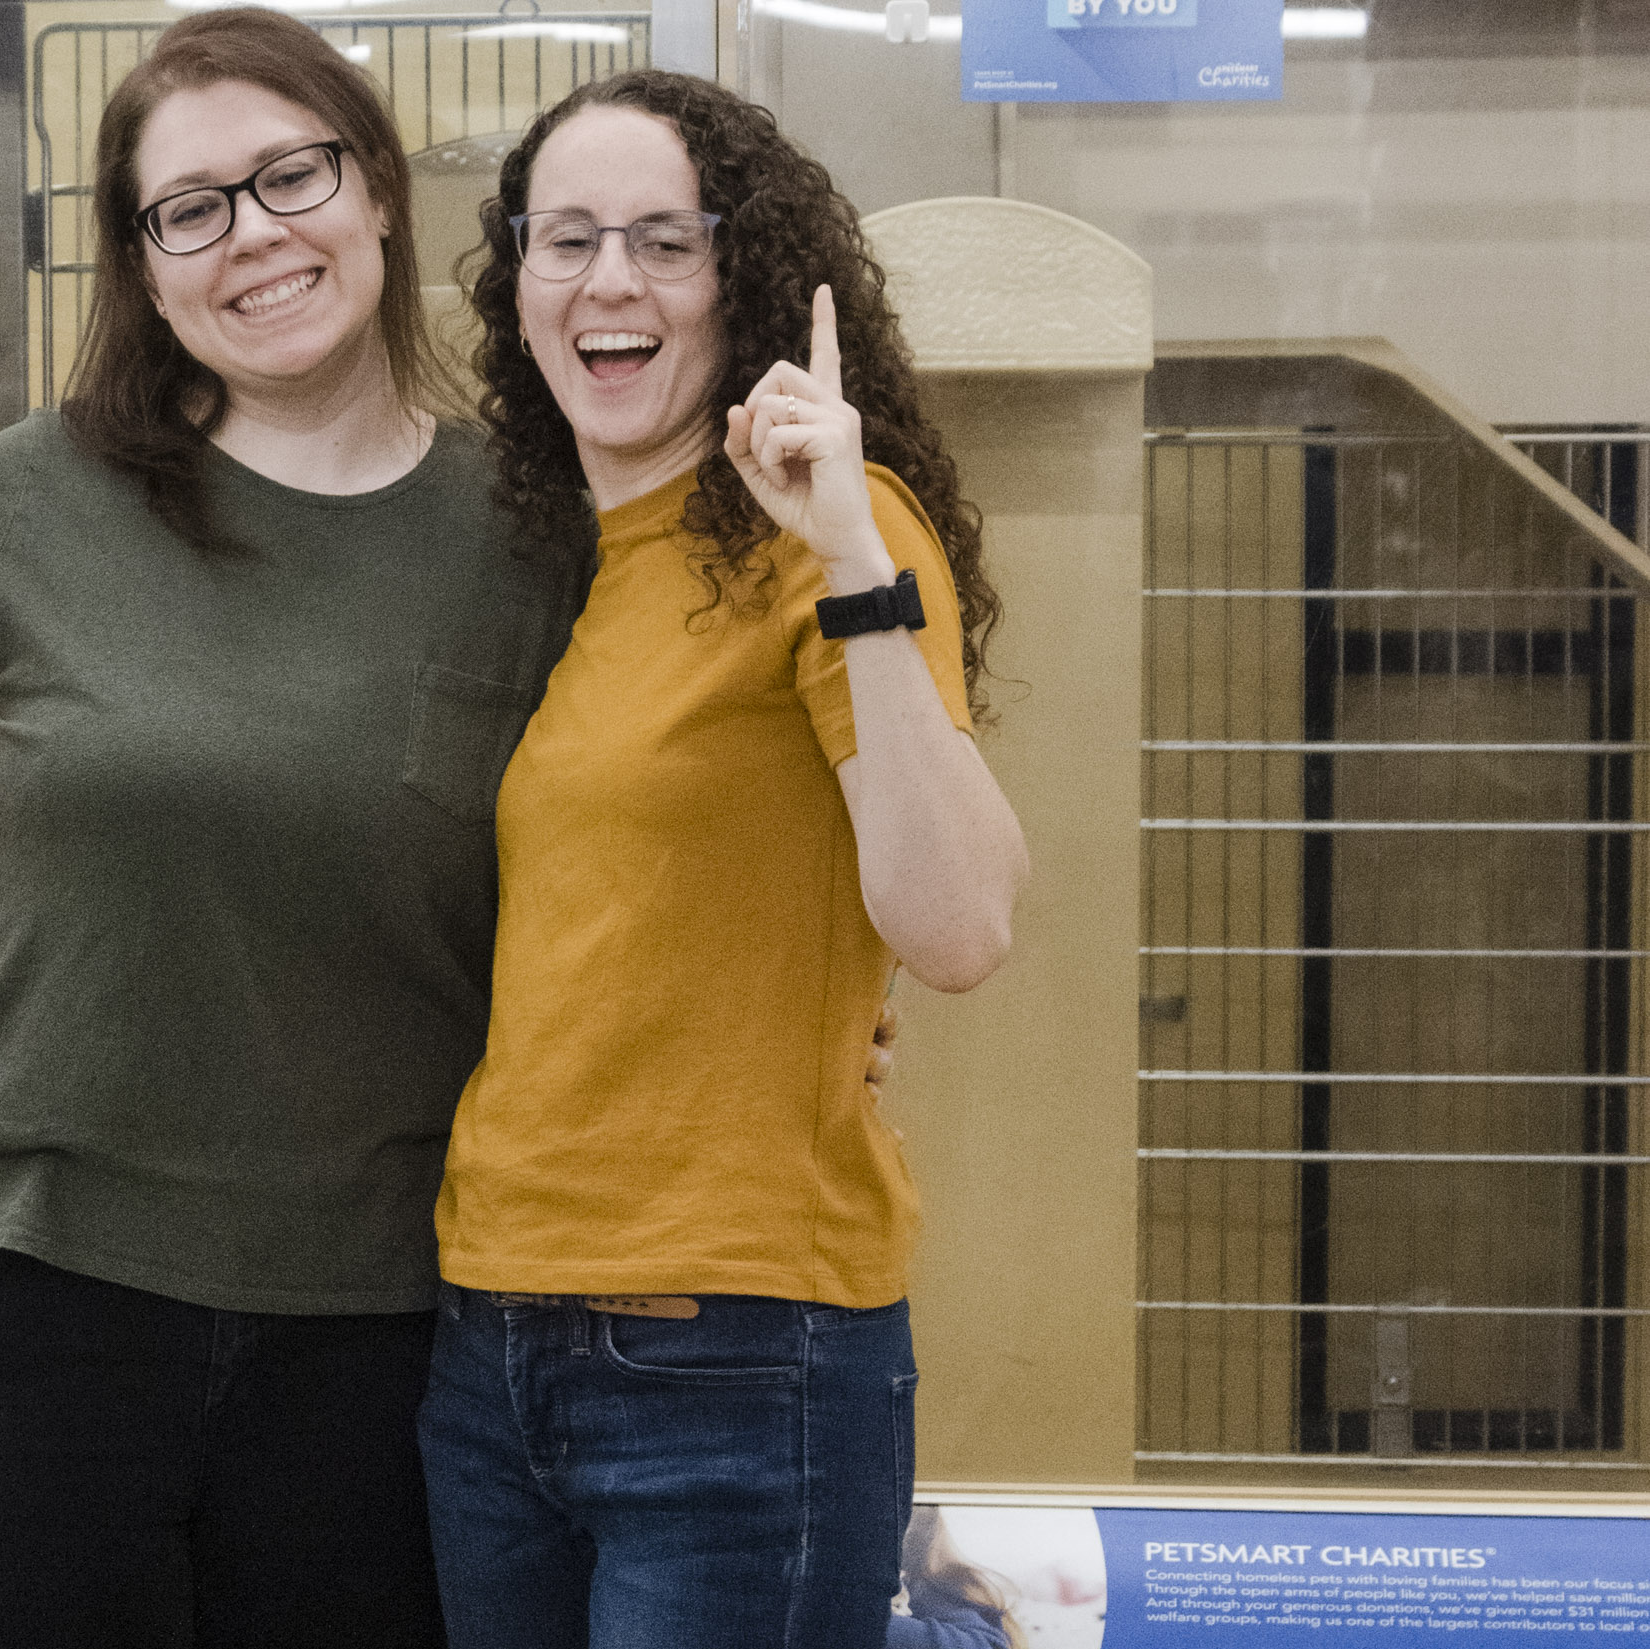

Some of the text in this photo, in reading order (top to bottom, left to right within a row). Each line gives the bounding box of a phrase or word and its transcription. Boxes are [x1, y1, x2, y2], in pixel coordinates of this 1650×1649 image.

[1144, 1542, 1312, 1564] PETSMART
[1145, 1568, 1635, 1590] Connecting homeless pets with loving families has been our focus
[1145, 1597, 1178, 1613] And
[1181, 1595, 1241, 1613] through
[1244, 1601, 1278, 1612] your
[1281, 1602, 1353, 1614] generous
[1355, 1599, 1434, 1614] donations,
[1438, 1604, 1482, 1615] we've
[1485, 1605, 1527, 1618] given
[1530, 1602, 1564, 1617] over
[1567, 1605, 1594, 1617] $31
